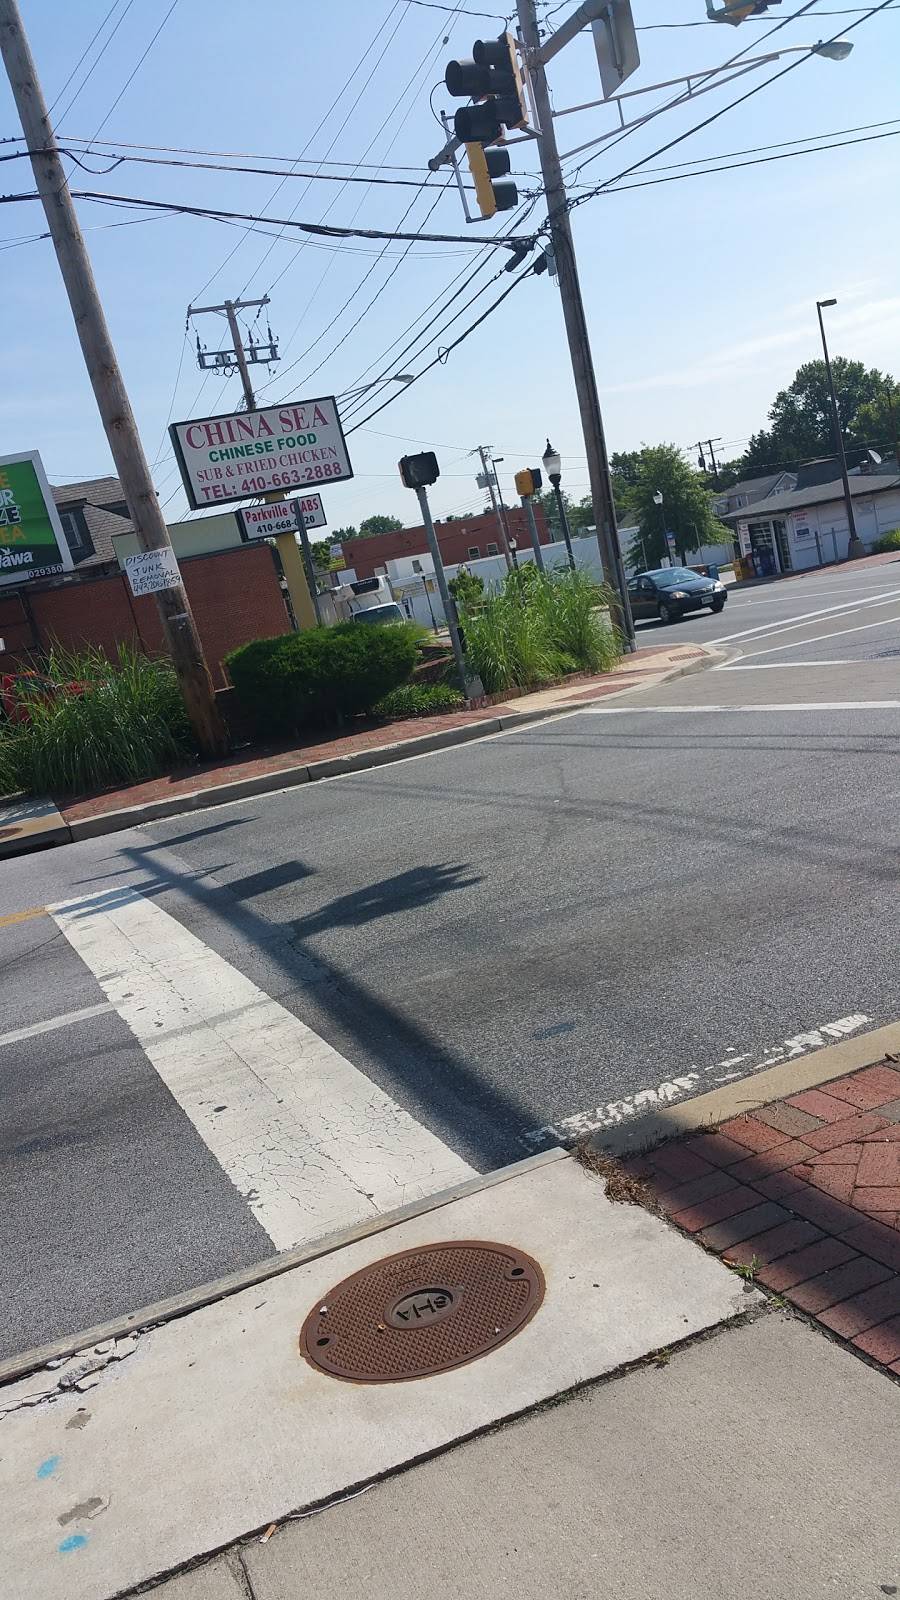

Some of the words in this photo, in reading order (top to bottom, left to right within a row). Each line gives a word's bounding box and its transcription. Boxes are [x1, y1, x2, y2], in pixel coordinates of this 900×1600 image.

[186, 414, 275, 449] CHINA
[279, 404, 329, 433] SEA
[209, 441, 275, 463] CHINESE
[277, 432, 317, 452] FOOD
[196, 465, 223, 483] SUB
[225, 465, 235, 477] &
[236, 458, 277, 475] FRIED
[279, 446, 338, 467] CHICKEN
[201, 483, 236, 501] TEL:
[241, 462, 342, 492] 410-663-2888
[245, 505, 288, 524] Parkville
[290, 498, 319, 514] CABS
[28, 565, 63, 579] 029380
[126, 550, 170, 566] DISCOUNT
[133, 563, 166, 576] JUNK
